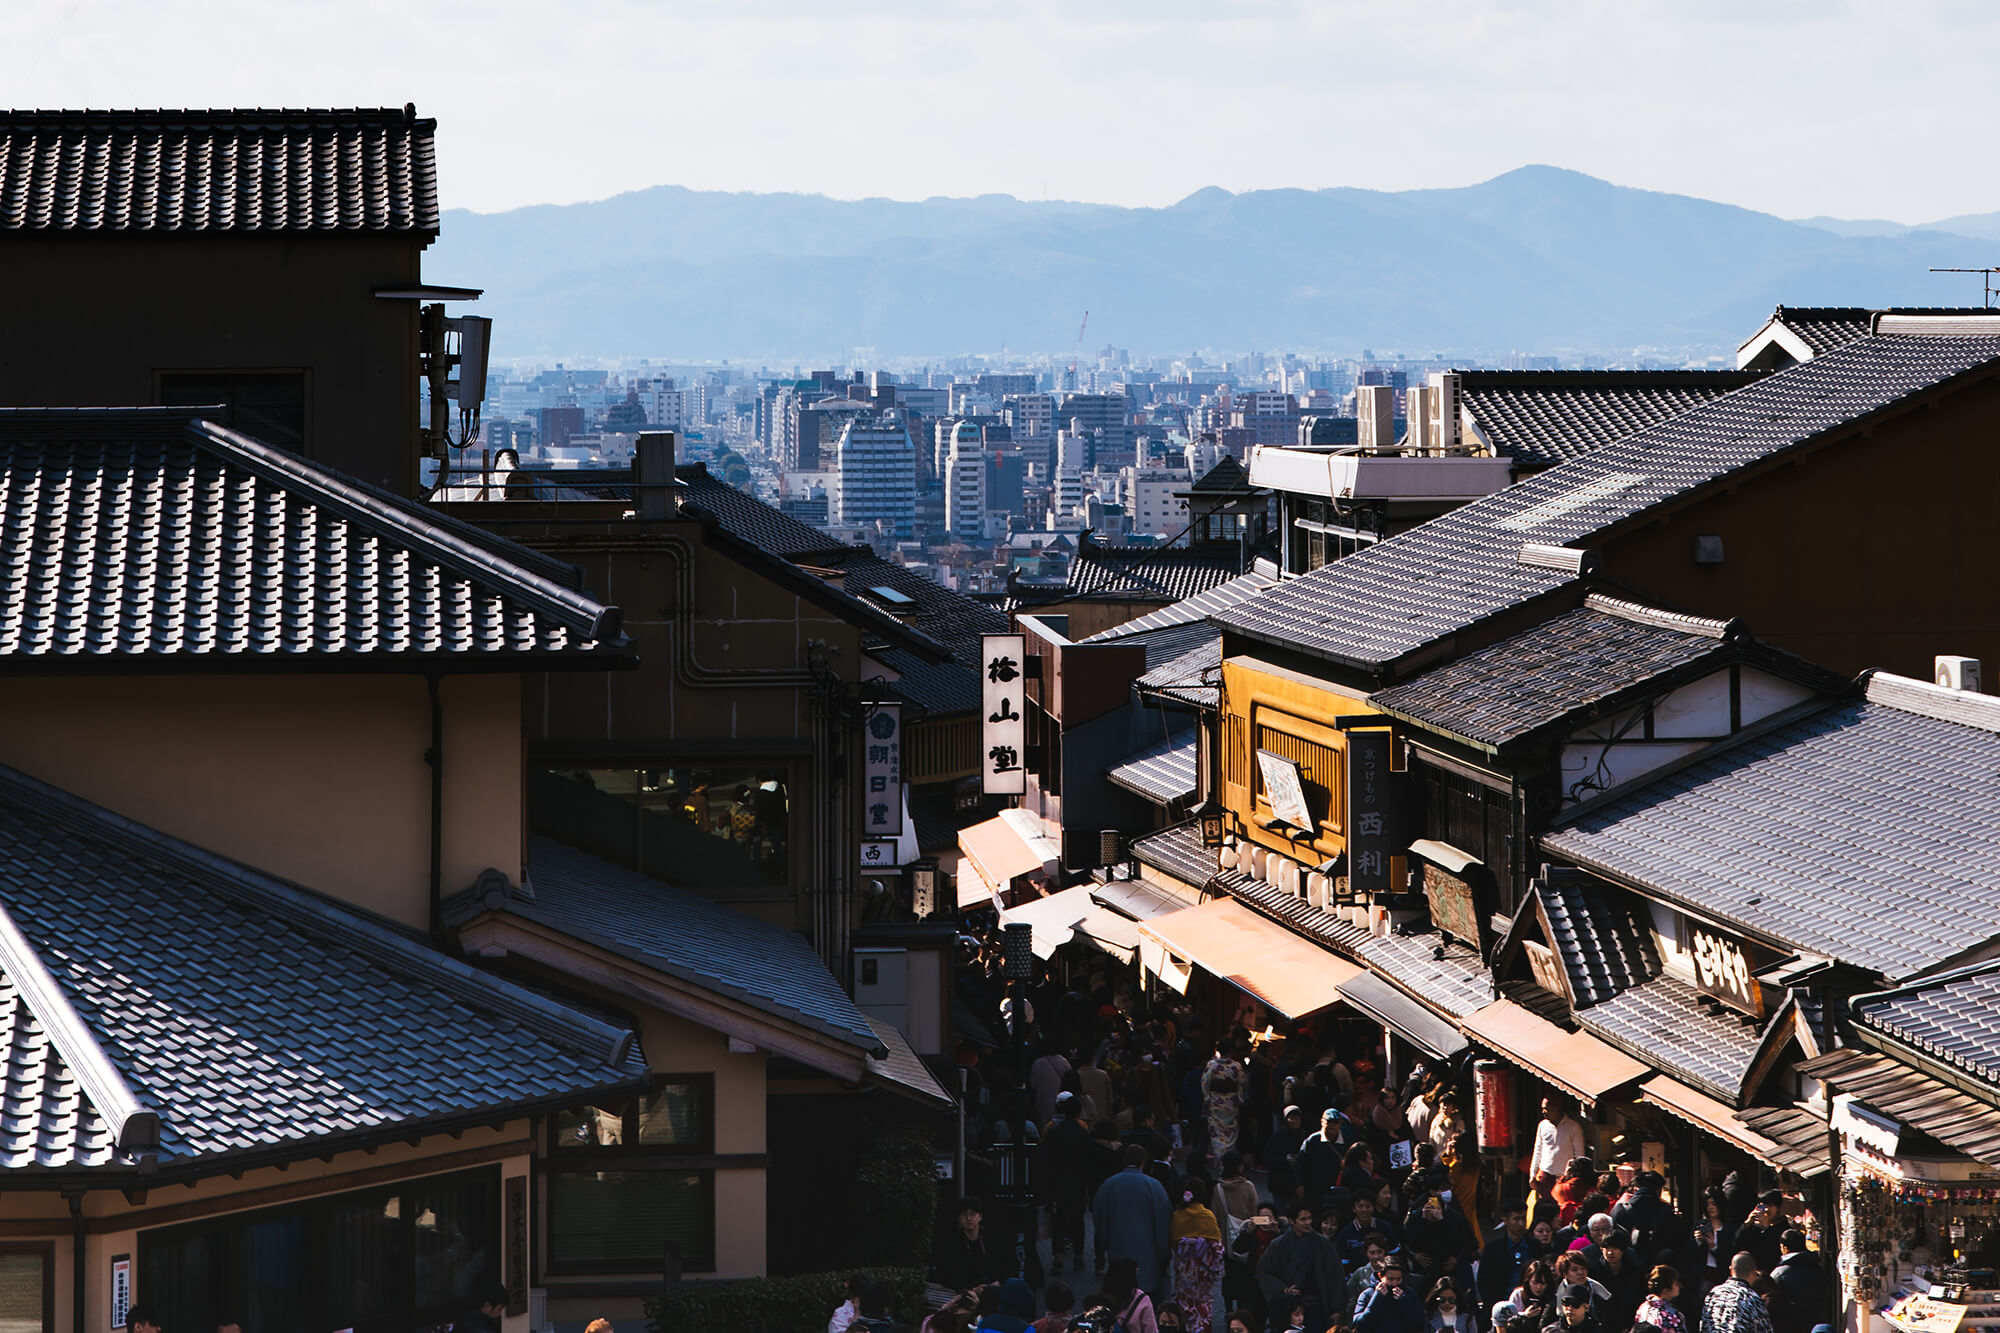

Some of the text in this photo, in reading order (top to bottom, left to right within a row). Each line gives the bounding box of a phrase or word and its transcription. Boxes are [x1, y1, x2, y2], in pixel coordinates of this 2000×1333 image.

[988, 656, 1023, 774] 梅山堂
[869, 745, 889, 825] 朝日堂
[1362, 748, 1376, 804] 京つけもの
[1357, 812, 1384, 877] 西利
